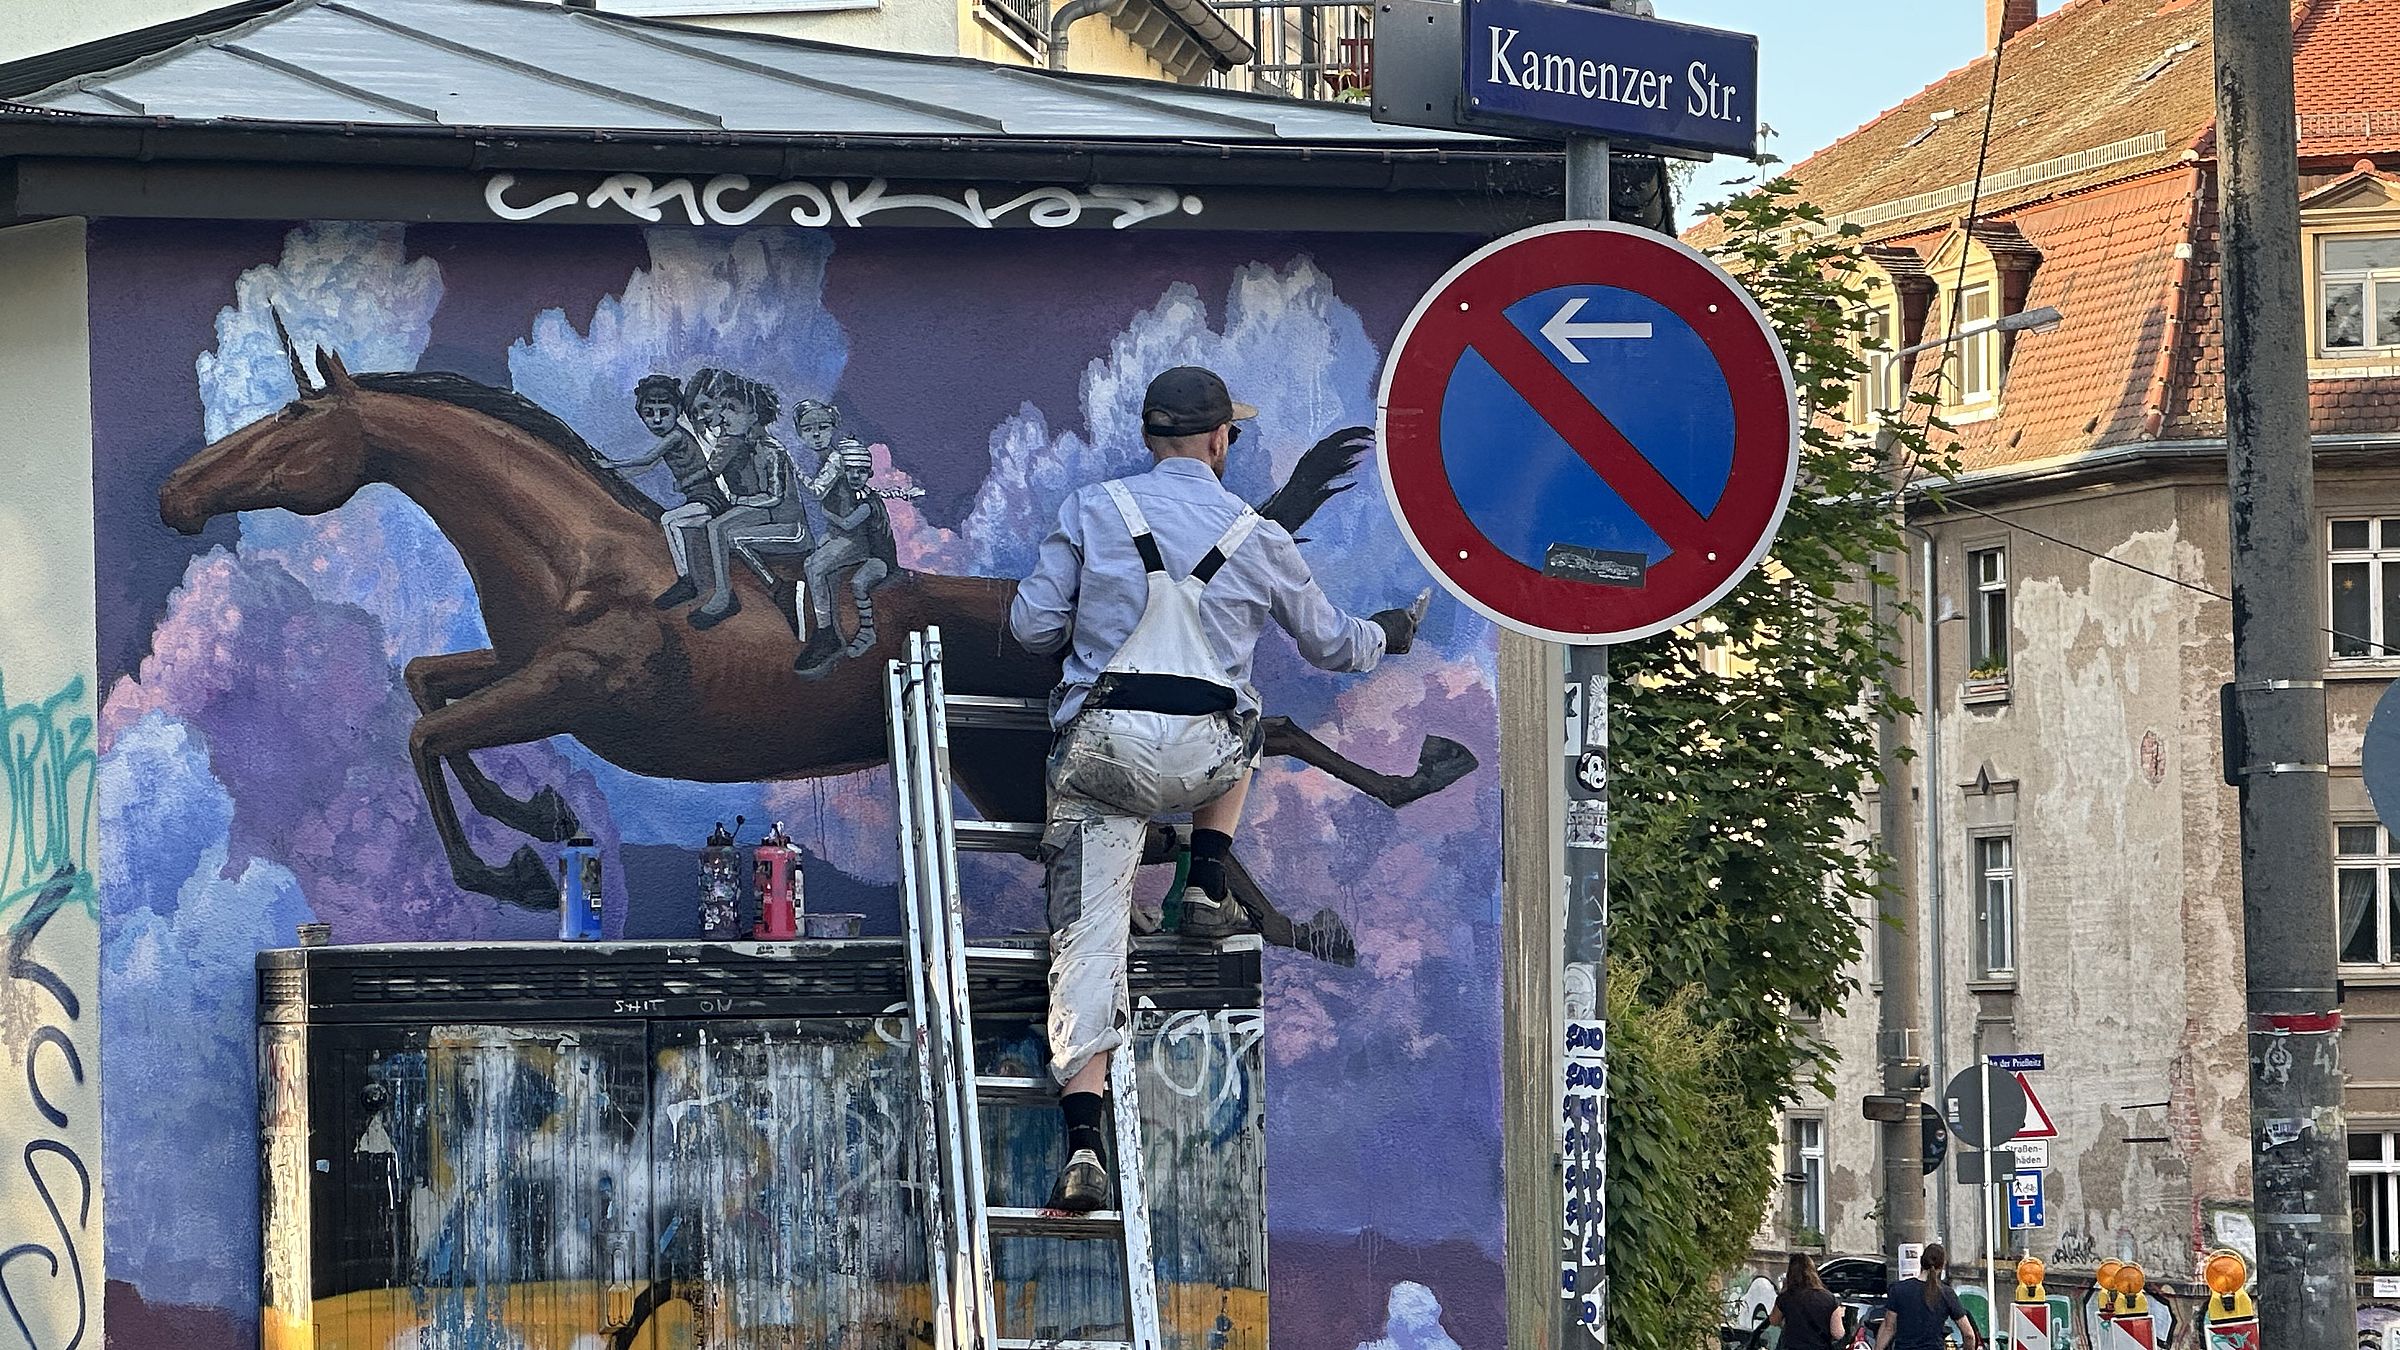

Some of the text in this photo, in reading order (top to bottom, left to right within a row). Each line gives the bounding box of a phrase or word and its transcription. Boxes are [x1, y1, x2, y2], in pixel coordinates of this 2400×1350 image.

[1488, 26, 1741, 123] Kamenzer Str.
[614, 999, 733, 1013] SHIT ON
[1999, 1058, 2010, 1068] der
[2005, 1144, 2042, 1153] Straßen-
[2017, 1156, 2041, 1164] häden
